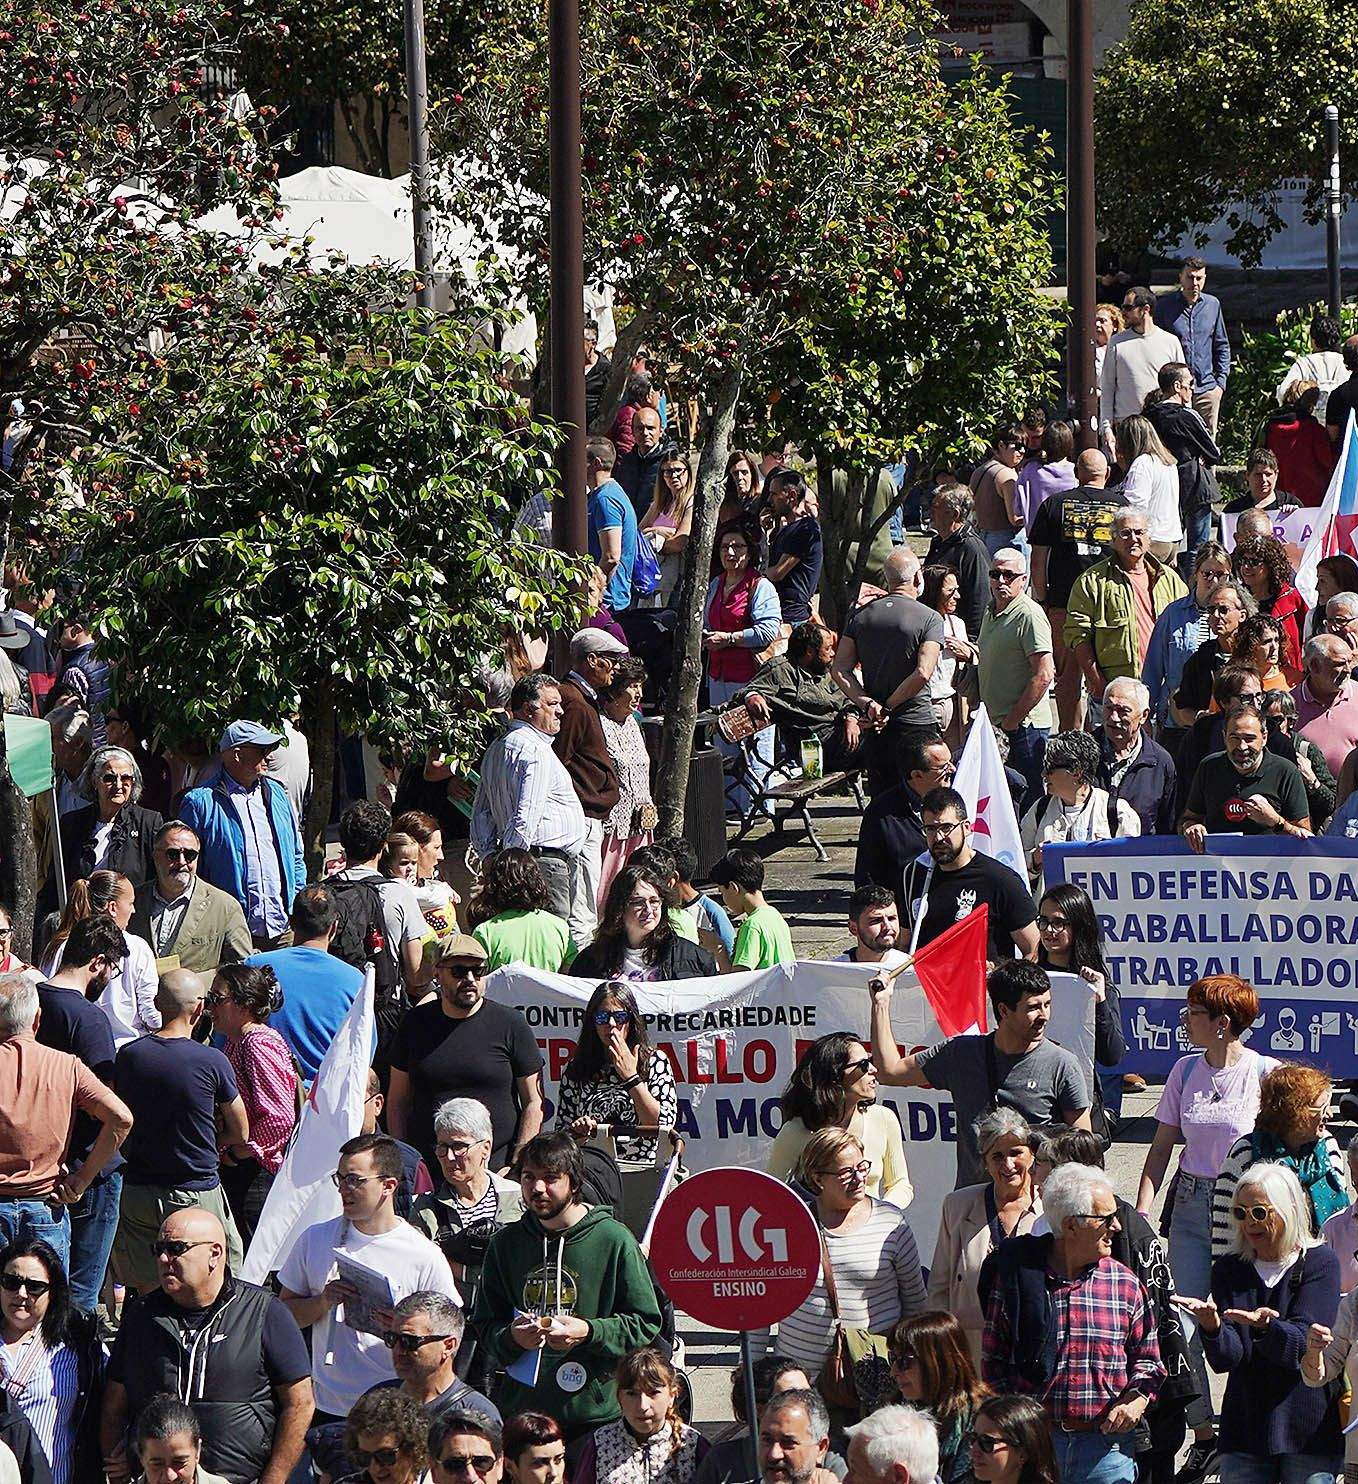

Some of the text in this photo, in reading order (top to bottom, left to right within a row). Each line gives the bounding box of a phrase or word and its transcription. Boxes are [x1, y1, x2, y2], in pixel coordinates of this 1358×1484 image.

[1071, 872, 1118, 900] EN
[1131, 871, 1298, 900] DEFENSA
[643, 1006, 817, 1032] PRECARIEDADE
[686, 1205, 789, 1263] CIG
[669, 1266, 807, 1279] Confederación Intersindical Galega
[713, 1281, 766, 1297] ENSINO
